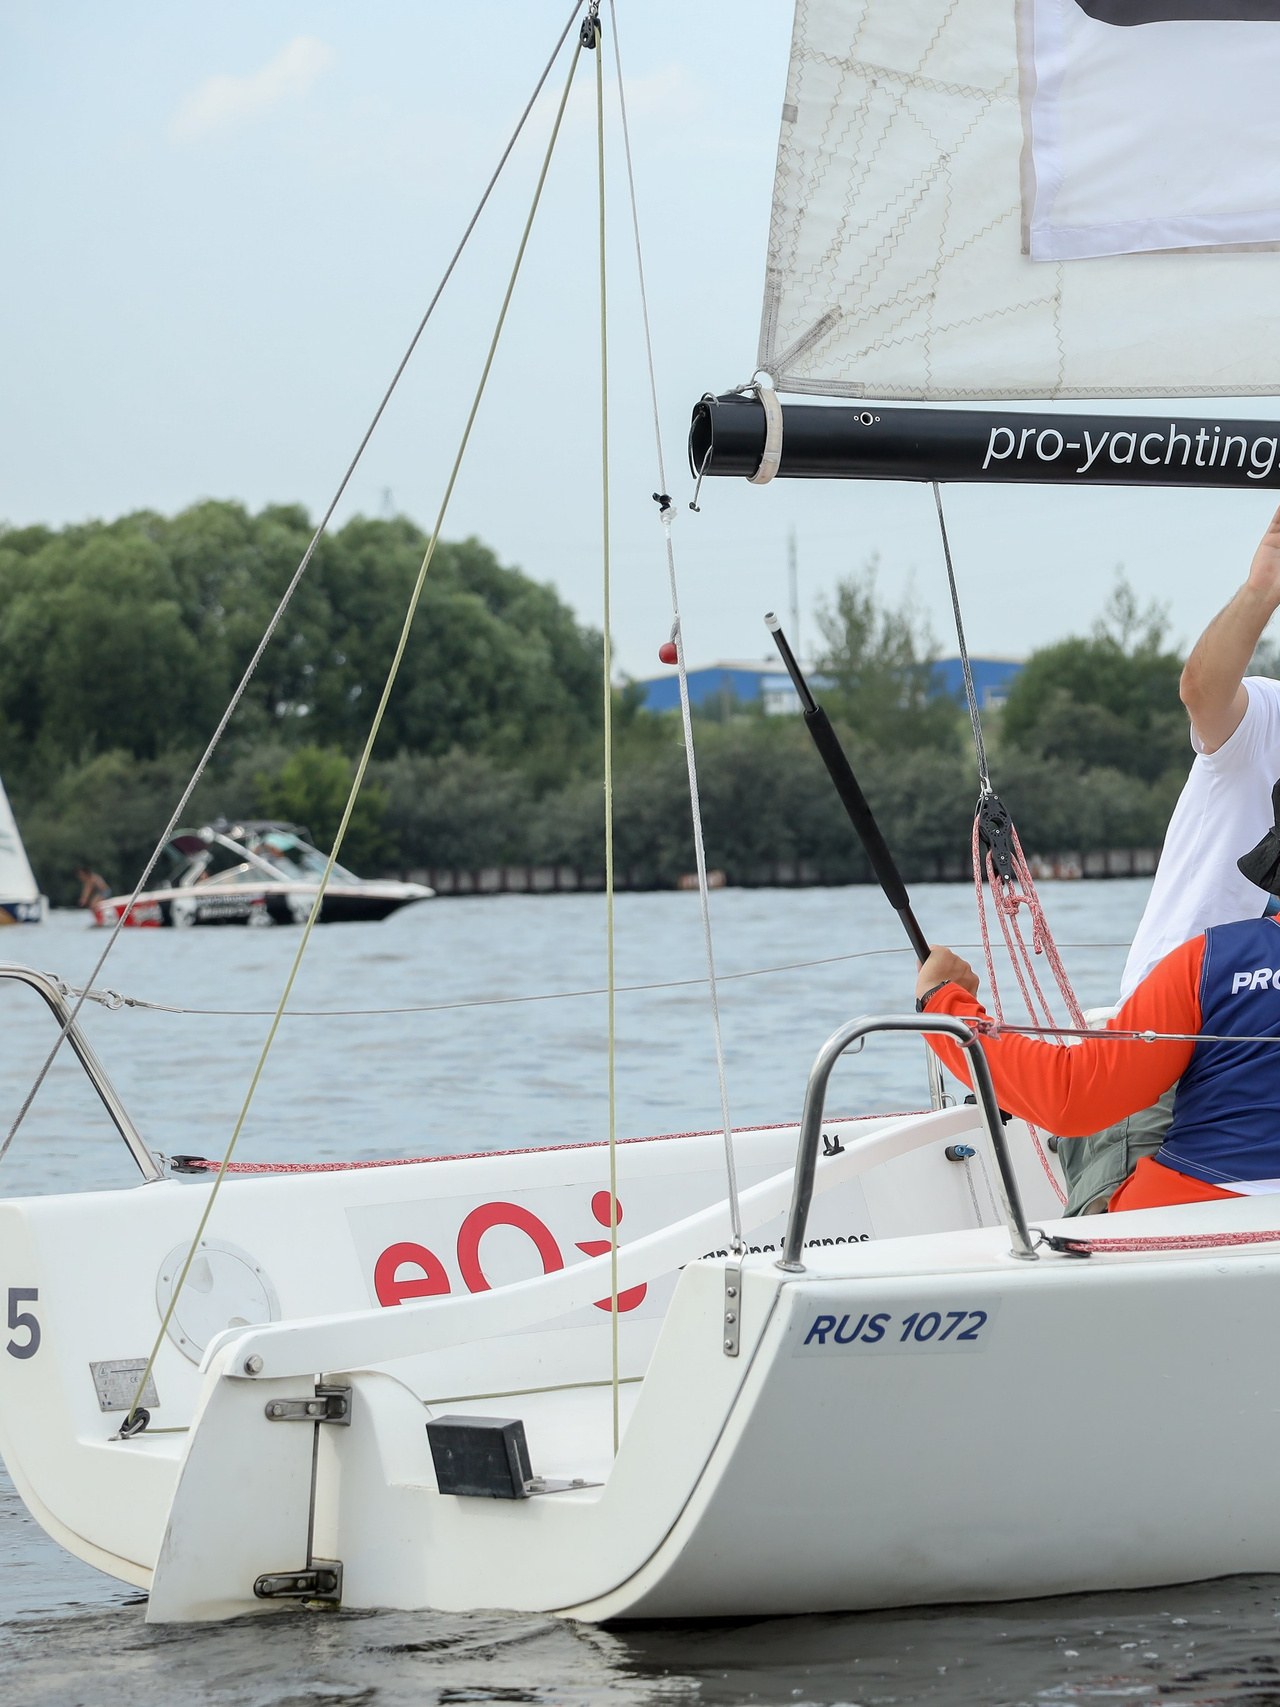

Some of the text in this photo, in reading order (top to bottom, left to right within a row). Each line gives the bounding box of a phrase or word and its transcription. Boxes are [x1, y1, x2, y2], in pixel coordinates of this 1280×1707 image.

[6, 1287, 41, 1360] 5
[803, 1310, 988, 1345] RUS 1072
